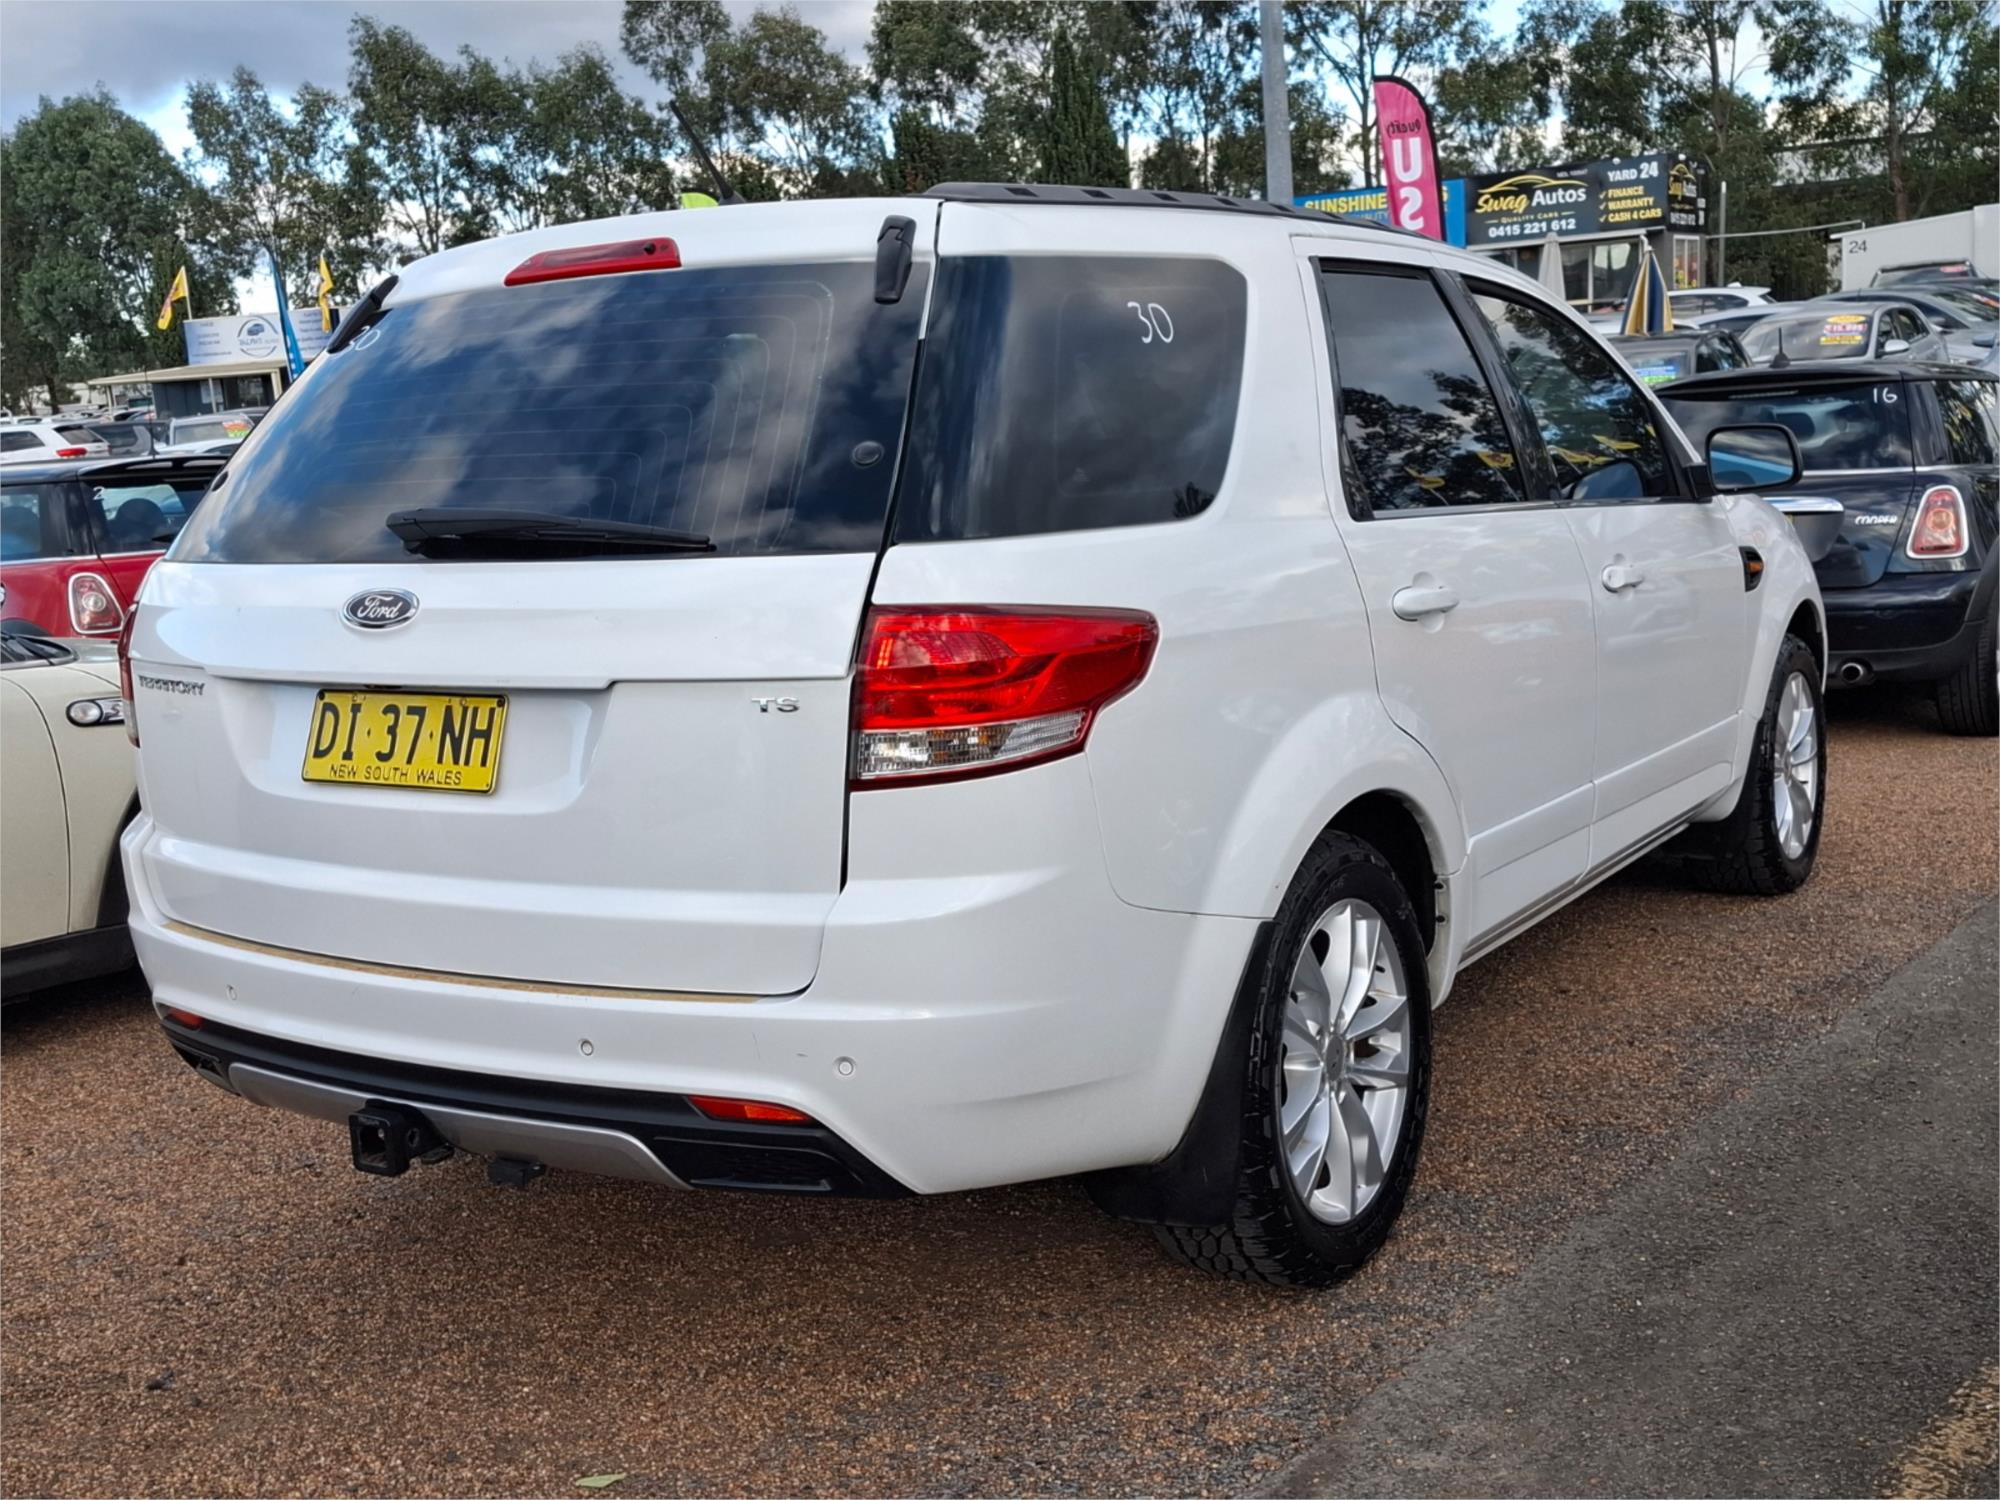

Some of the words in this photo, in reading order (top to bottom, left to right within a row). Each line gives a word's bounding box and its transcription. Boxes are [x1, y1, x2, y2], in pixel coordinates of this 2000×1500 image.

[1607, 168, 1638, 182] YARD
[1640, 161, 1659, 179] 24
[1474, 194, 1529, 214] Swag
[1531, 187, 1587, 207] Autos
[1608, 186, 1644, 198] FINANCE
[1304, 192, 1388, 213] SUNSHINE
[1608, 197, 1655, 210] WARRANTY
[1608, 211, 1631, 222] CASH
[1632, 211, 1639, 219] 4
[1640, 208, 1662, 219] CARS
[1488, 224, 1520, 238] 0415
[1523, 221, 1547, 234] 221
[1551, 218, 1576, 231] 612
[1849, 240, 1866, 253] 24
[1127, 301, 1174, 343] 30
[1873, 387, 1898, 403] 16
[357, 595, 403, 618] Ford
[138, 675, 205, 696] TERRITORY
[751, 697, 800, 713] TS
[330, 764, 358, 778] NEW
[364, 766, 409, 782] SOUTH
[416, 770, 463, 786] WALES
